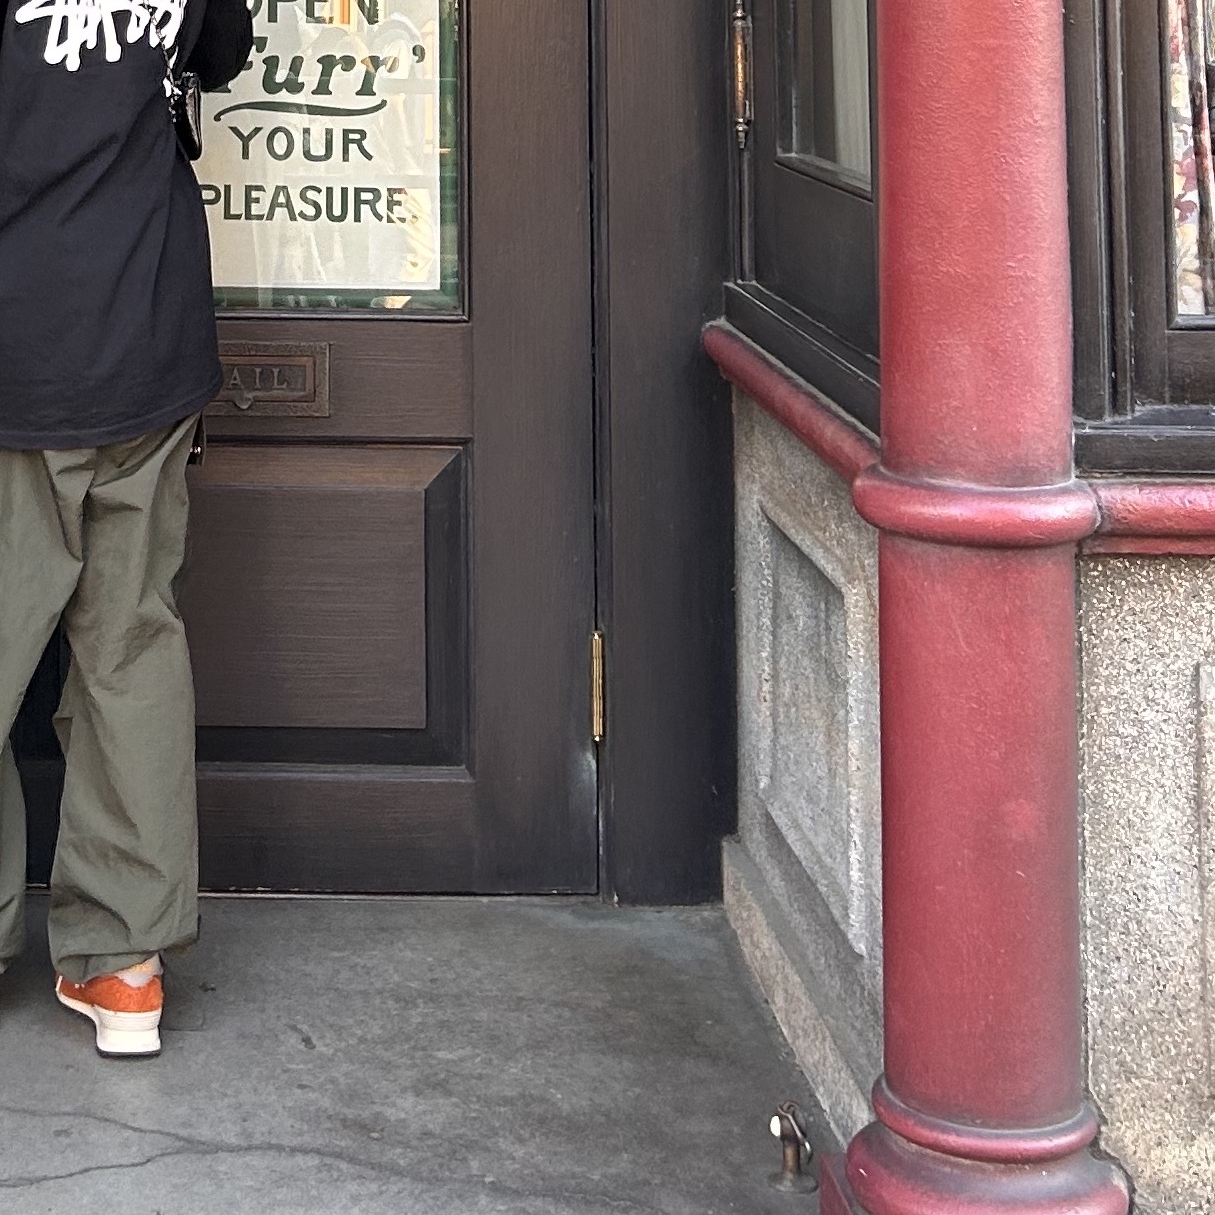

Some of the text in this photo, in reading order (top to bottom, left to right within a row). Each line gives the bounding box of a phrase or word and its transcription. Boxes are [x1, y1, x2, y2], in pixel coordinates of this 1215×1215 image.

[209, 35, 426, 96] urr'
[227, 125, 374, 163] YOUR
[227, 367, 288, 390] AIL
